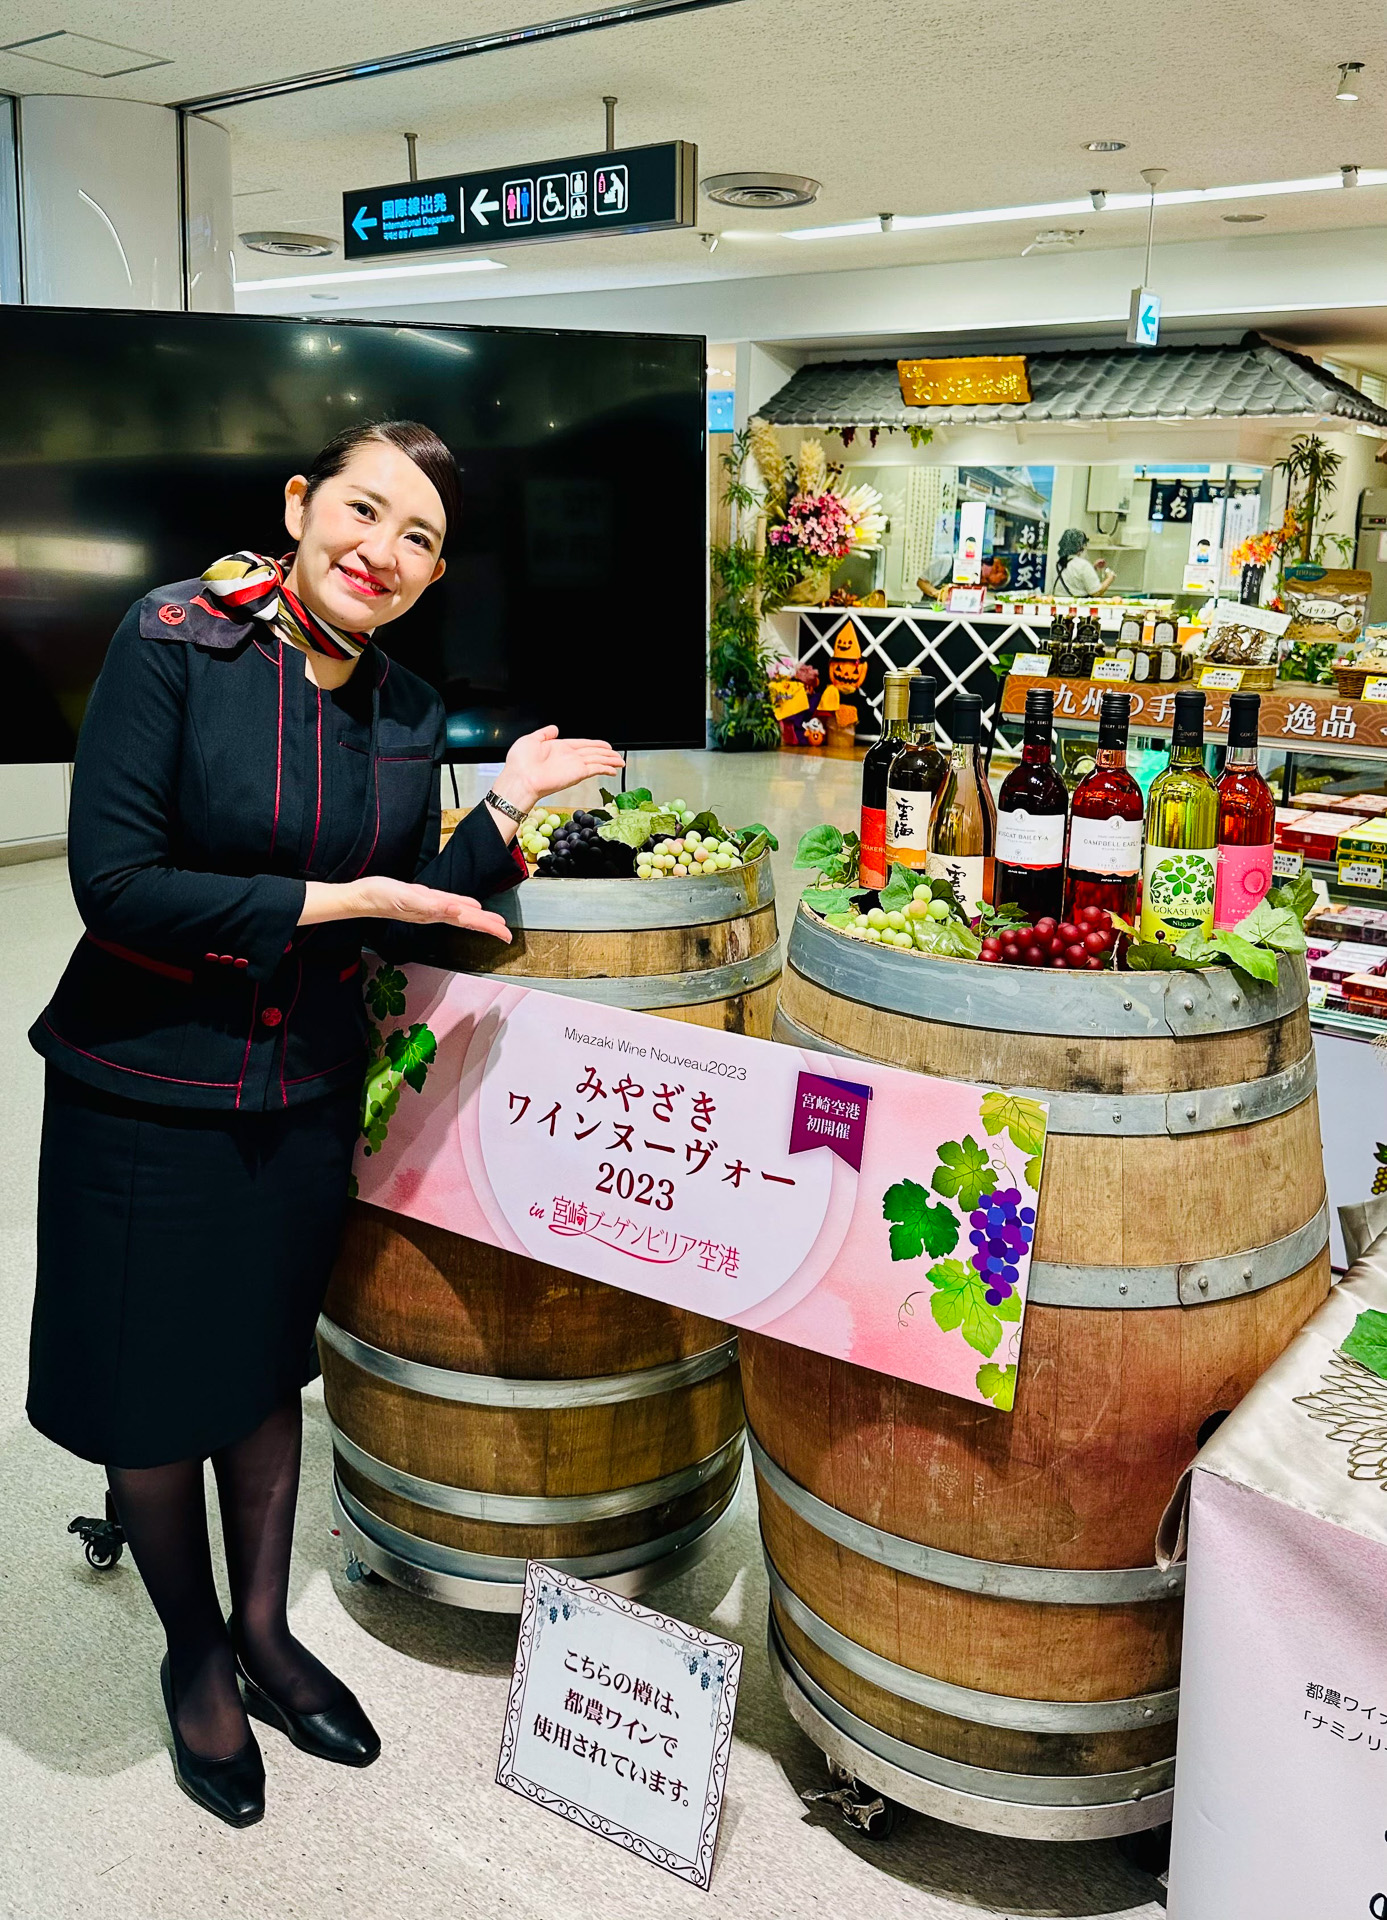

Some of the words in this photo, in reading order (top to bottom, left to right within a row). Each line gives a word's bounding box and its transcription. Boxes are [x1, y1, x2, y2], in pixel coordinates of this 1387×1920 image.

[382, 193, 447, 220] 国際線出発
[382, 217, 421, 231] International
[422, 214, 455, 226] Departure
[1014, 523, 1036, 589] おび天
[1281, 702, 1357, 739] 逸品
[893, 797, 915, 839] 雲海
[1083, 838, 1121, 847] CAMPBELL
[1153, 905, 1189, 916] GOKASE
[1191, 907, 1211, 916] WINE
[1172, 920, 1195, 928] Niagara
[564, 1027, 614, 1051] Miyazaki
[617, 1039, 646, 1058] Wine
[650, 1048, 748, 1082] Nouveau2023
[576, 1065, 718, 1132] みやざき
[802, 1092, 861, 1120] 宮崎空港
[507, 1091, 796, 1189] ワインヌーヴォー
[806, 1115, 851, 1140] 初開催
[595, 1162, 675, 1212] 2023
[528, 1202, 545, 1219] in
[550, 1195, 741, 1279] 宮崎ブーゲンビリア空港
[563, 1648, 680, 1719] こちらの樽は、
[564, 1688, 679, 1759] 都農ワインで
[1304, 1710, 1387, 1751] 「ナミノリ
[532, 1713, 690, 1808] 使用されています。
